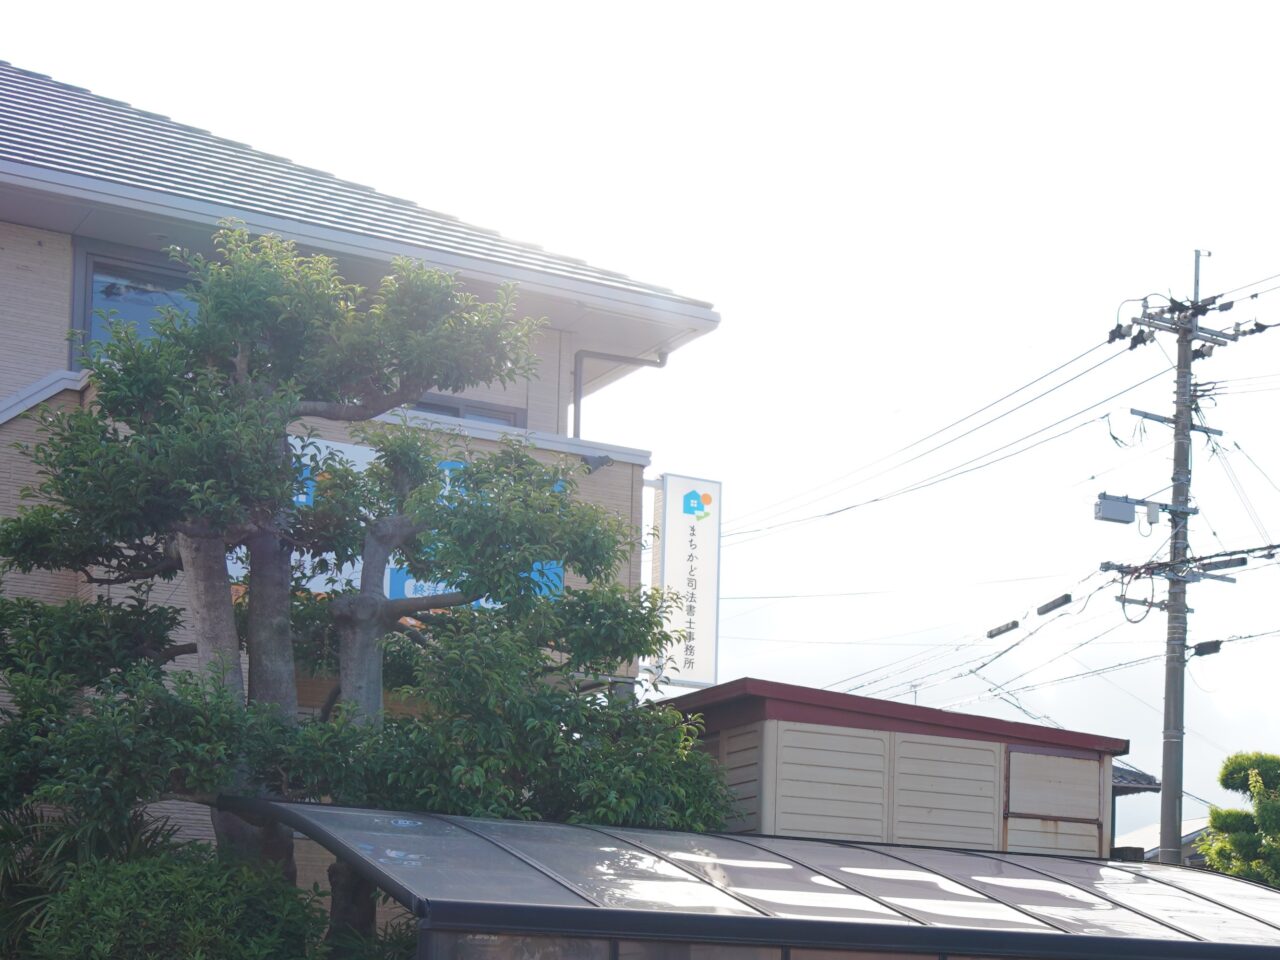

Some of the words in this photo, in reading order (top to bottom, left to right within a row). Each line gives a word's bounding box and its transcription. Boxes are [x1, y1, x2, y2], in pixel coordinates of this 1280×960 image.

[683, 525, 698, 670] まちかど司法書士事務所
